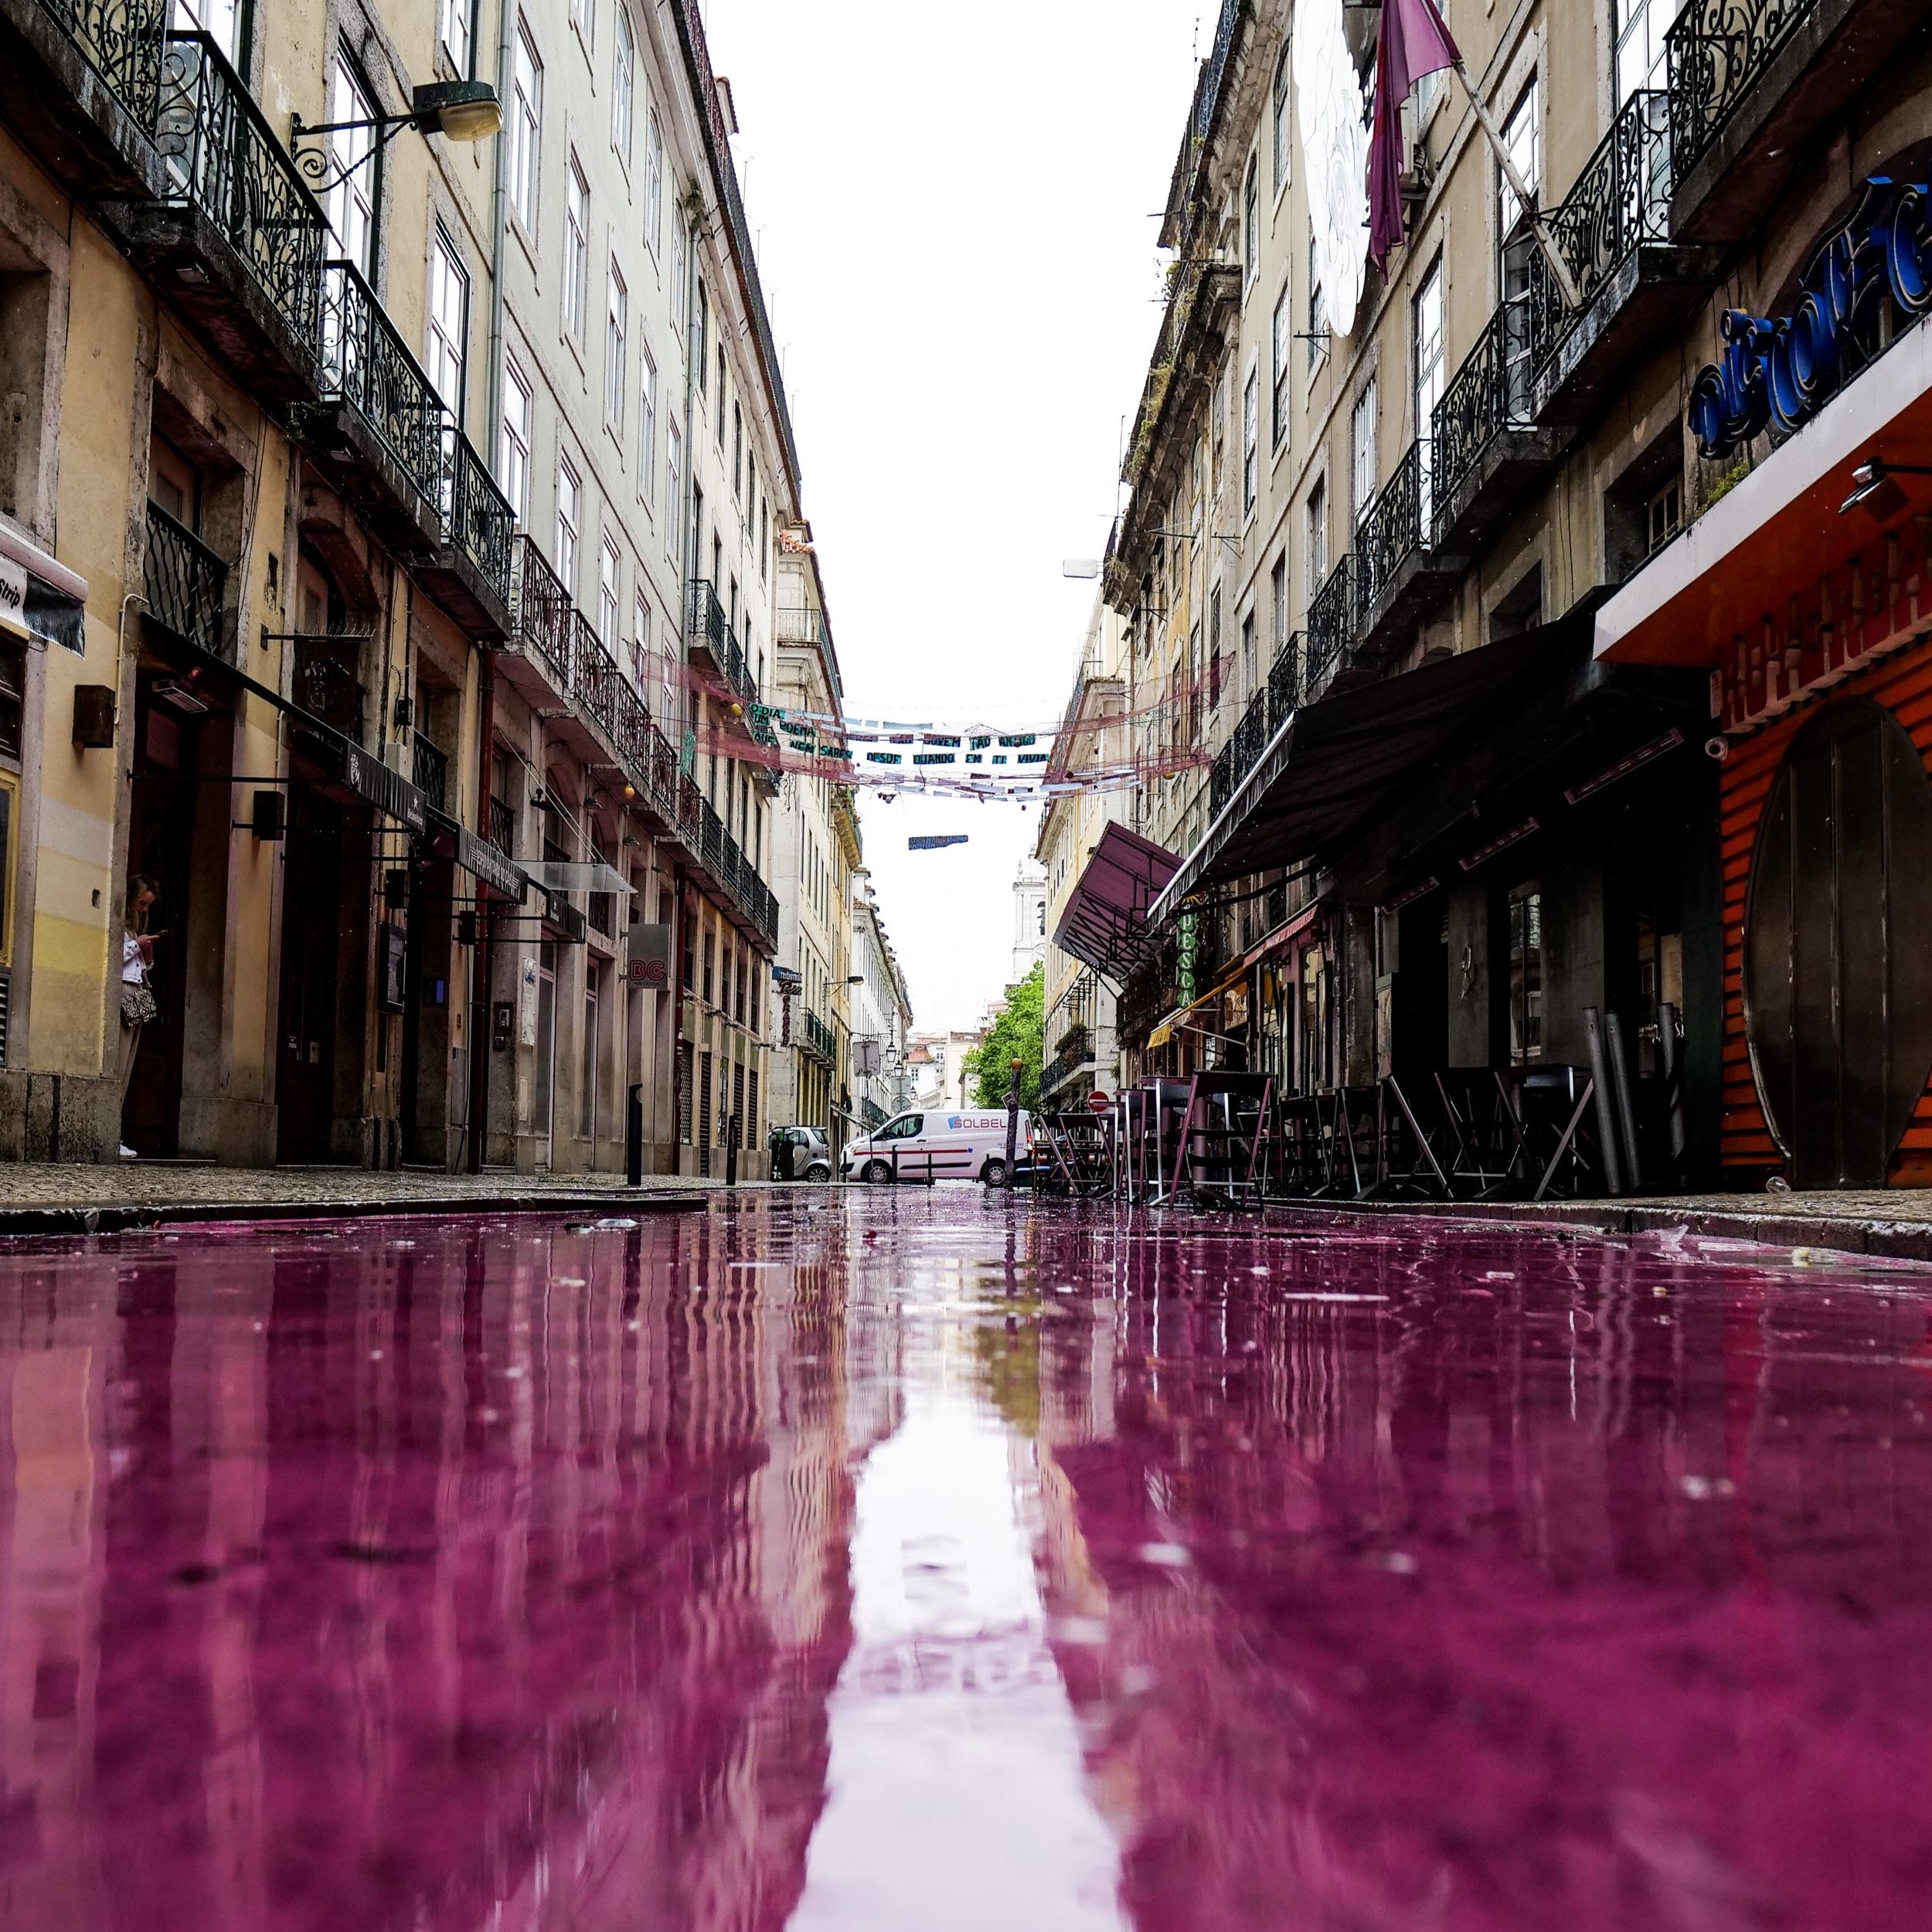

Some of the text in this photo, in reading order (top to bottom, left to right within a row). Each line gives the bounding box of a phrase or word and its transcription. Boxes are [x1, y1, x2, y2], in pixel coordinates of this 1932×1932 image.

[761, 706, 781, 719] DIA
[754, 713, 816, 736] UM POEMA
[790, 739, 816, 753] NEM
[820, 745, 853, 759] SABES
[867, 752, 902, 764] DESDE
[913, 753, 955, 764] QUANDO
[965, 753, 982, 764] EM
[993, 755, 1005, 764] TI
[1017, 753, 1047, 764] VIVIA
[630, 959, 665, 981] BC
[1181, 913, 1192, 1007] PESCA
[954, 1118, 1007, 1128] SOLBEL
